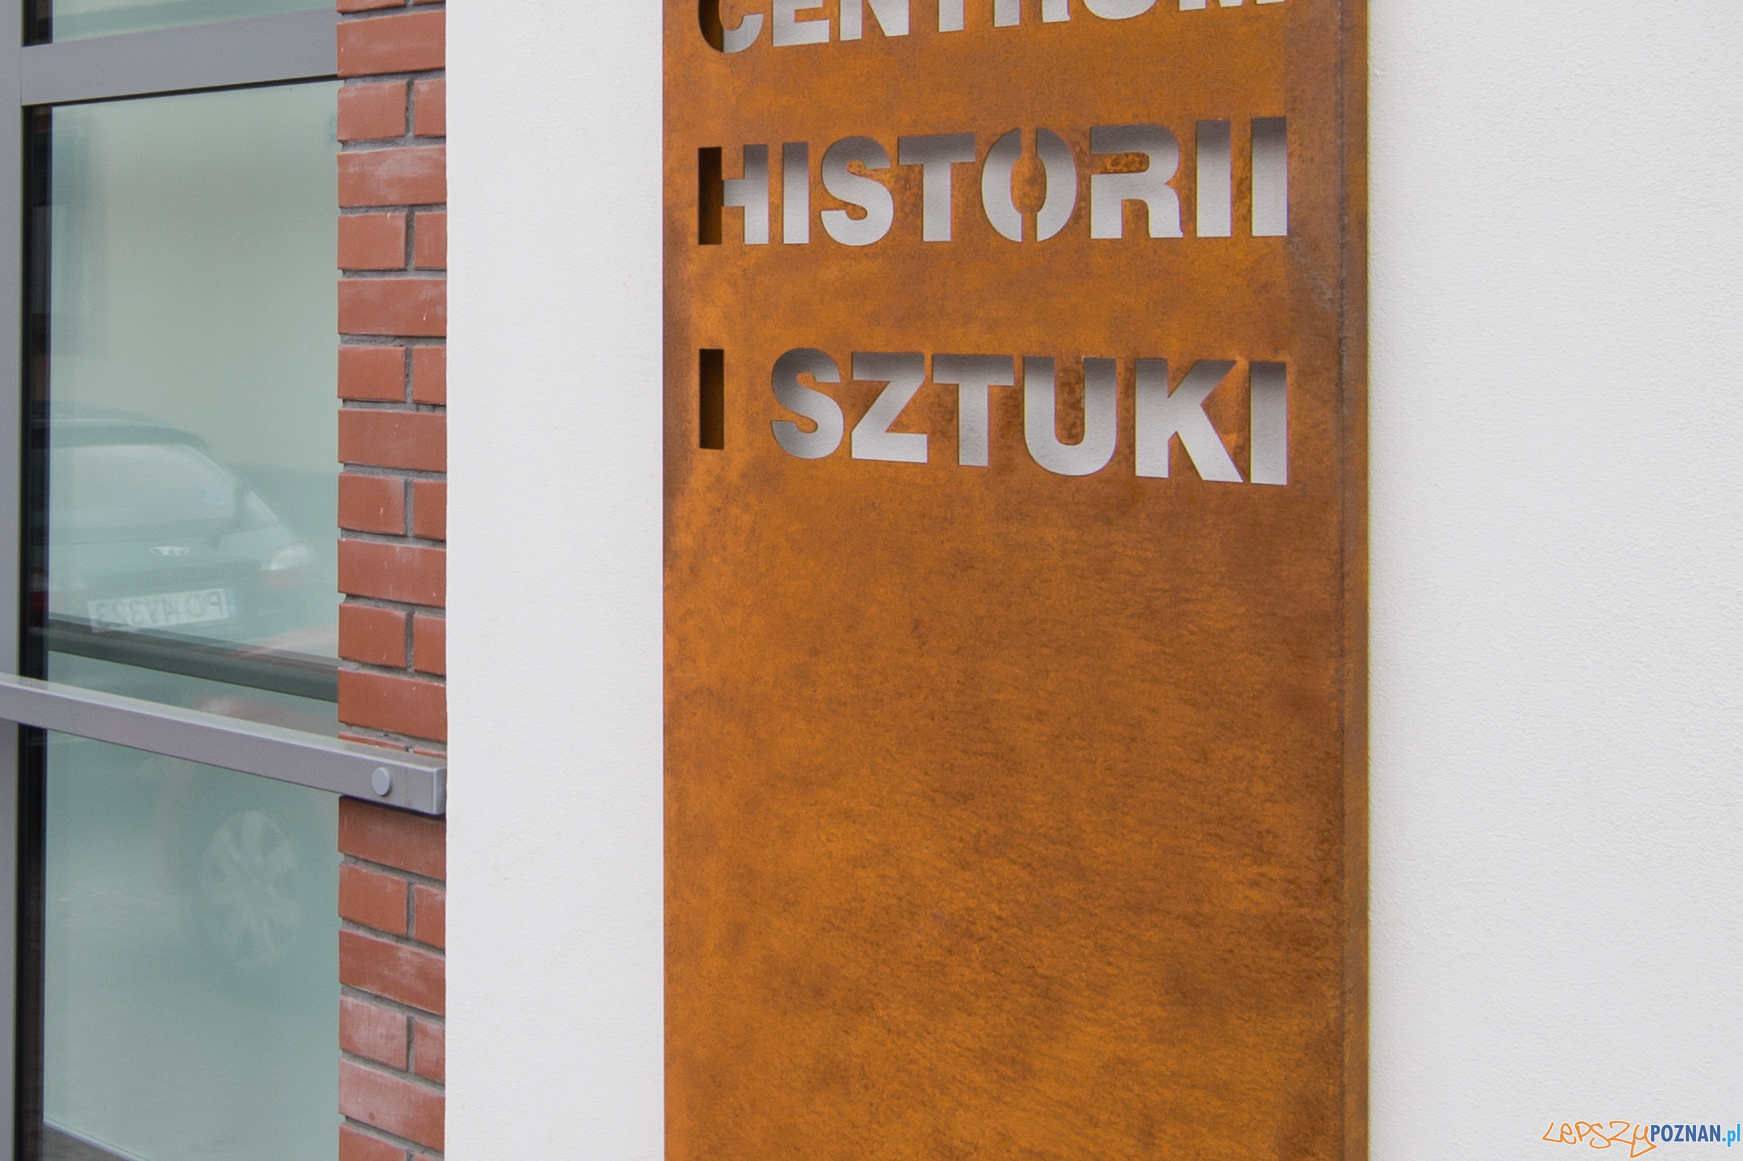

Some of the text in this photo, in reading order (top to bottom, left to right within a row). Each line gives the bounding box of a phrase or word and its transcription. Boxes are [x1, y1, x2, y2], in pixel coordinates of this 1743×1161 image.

[698, 116, 1287, 245] HISTORII
[699, 347, 1288, 486] I SZTUKI
